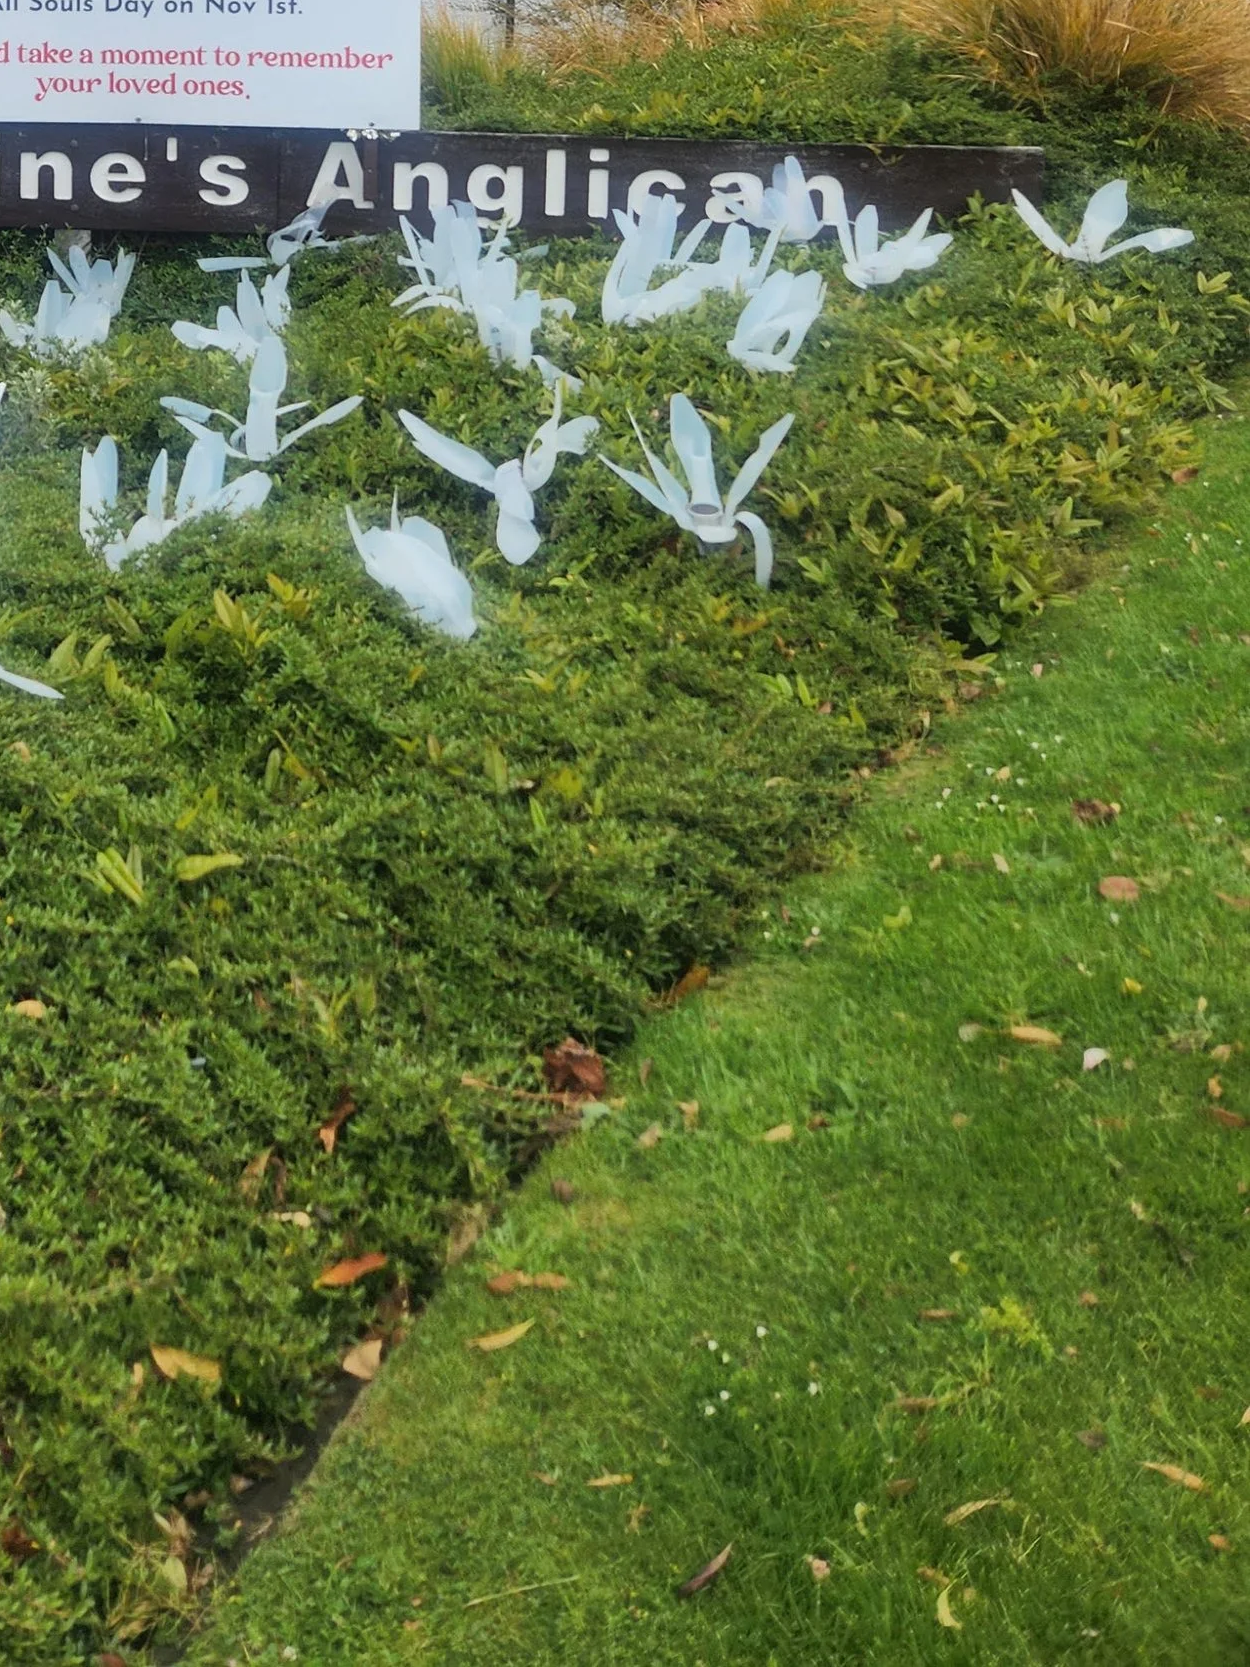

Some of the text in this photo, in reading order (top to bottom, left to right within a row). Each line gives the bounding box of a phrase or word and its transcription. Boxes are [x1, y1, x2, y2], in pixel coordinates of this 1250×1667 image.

[165, 1, 192, 13] on
[18, 42, 72, 63] take
[80, 49, 93, 63] a
[101, 47, 206, 65] moment
[214, 47, 240, 66] to
[248, 47, 393, 68] remember
[35, 72, 250, 101] your loved ones.
[306, 141, 846, 230] Anglican
